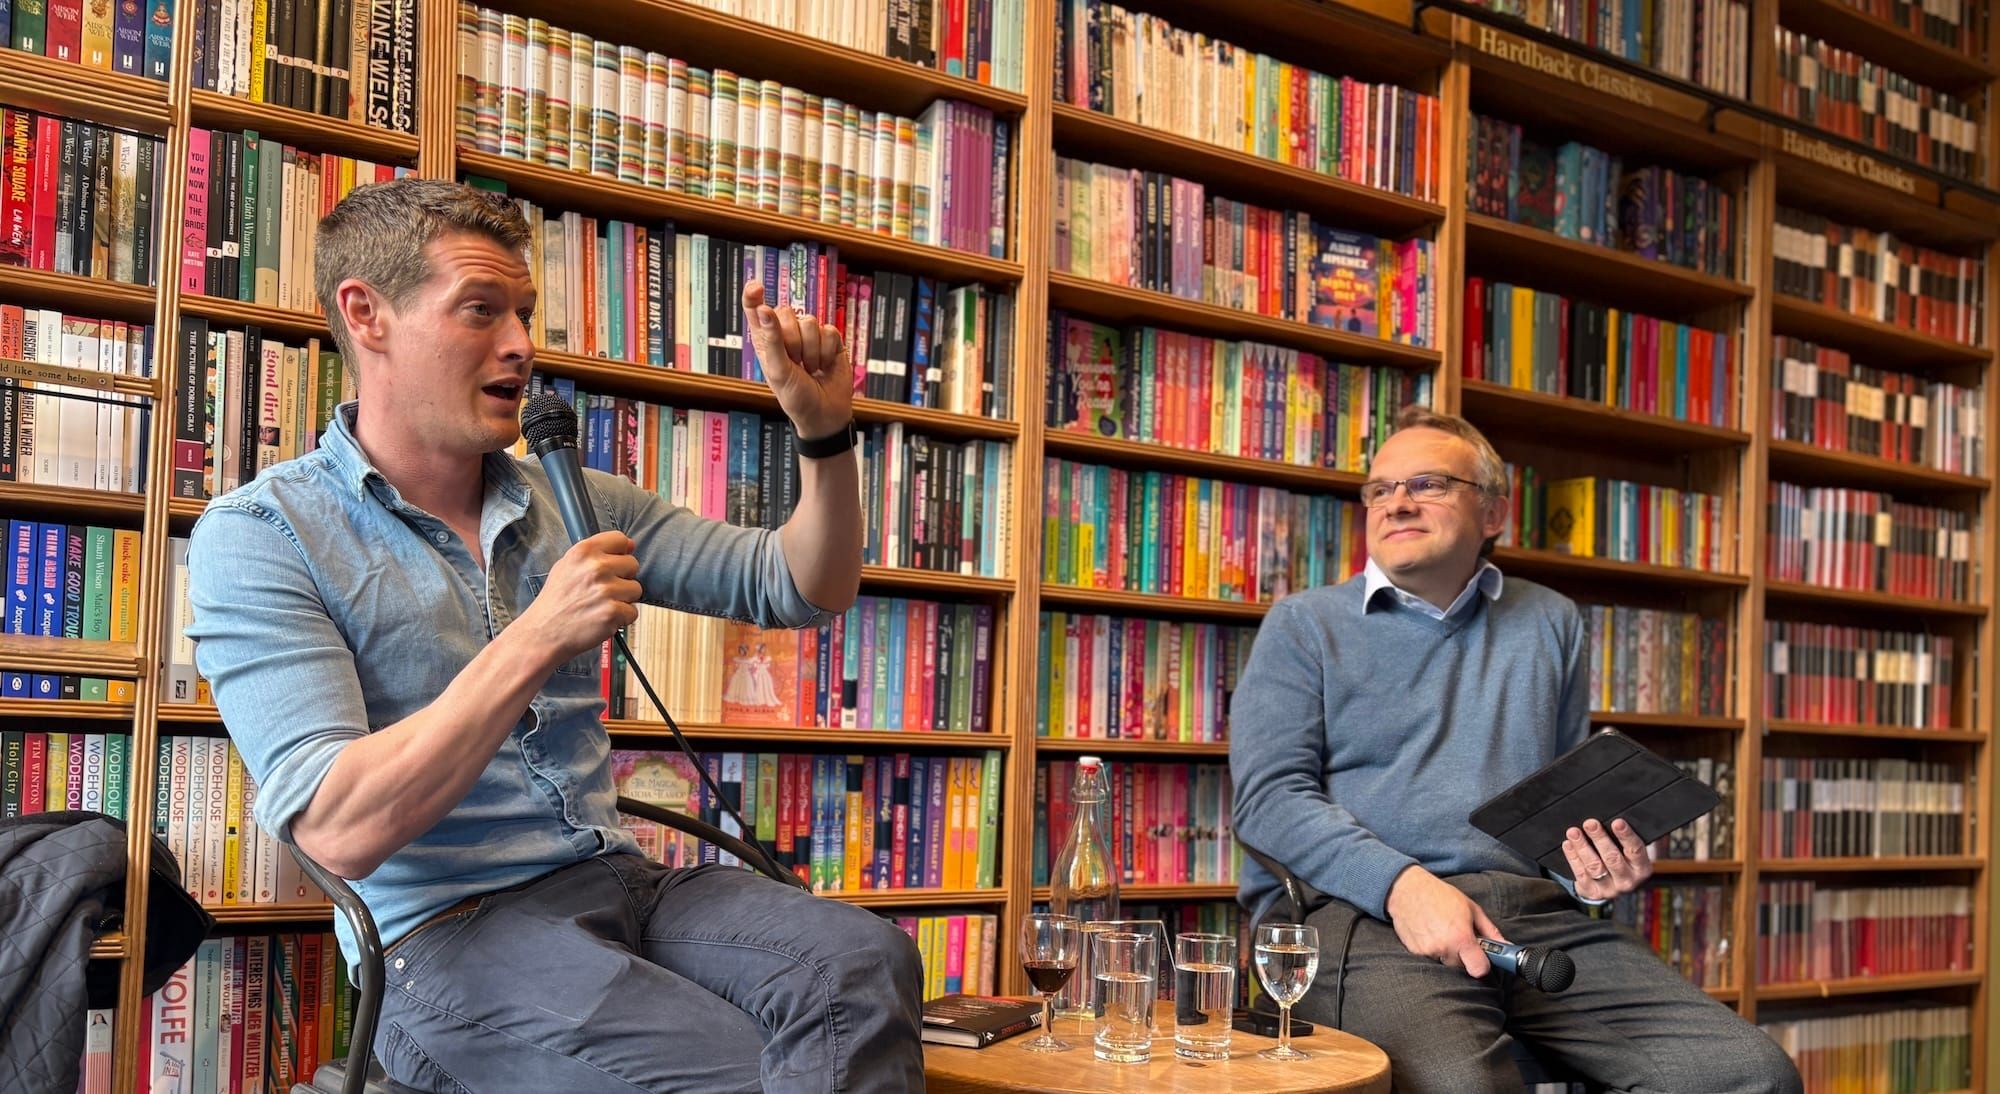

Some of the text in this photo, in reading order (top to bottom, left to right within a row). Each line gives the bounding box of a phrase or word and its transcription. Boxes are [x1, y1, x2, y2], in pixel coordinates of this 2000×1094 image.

[1479, 26, 1652, 106] Hardback Classics
[63, 137, 75, 166] Wesley
[81, 139, 93, 168] Wesley
[119, 146, 131, 174] Wesley
[191, 151, 205, 163] YOU
[1782, 129, 1915, 194] Hardback Classics
[99, 136, 109, 213] Wesley Second Fiddle
[188, 179, 205, 190] NOW
[190, 165, 204, 176] MAY
[11, 166, 26, 245] SQUARE LAI WEN
[188, 193, 203, 203] KILL
[189, 206, 203, 217] THE
[79, 209, 88, 232] Legacy
[185, 219, 205, 231] BRIDE
[242, 196, 255, 257] Edith Wharton
[137, 239, 145, 270] WEDDING
[184, 258, 204, 268] WESTON
[187, 250, 200, 258] KATE
[1322, 252, 1369, 270] JIMENEZ
[648, 238, 661, 331] FOURTEEN DAYS
[4, 335, 10, 345] Be
[13, 365, 89, 384] like some help.
[188, 345, 197, 373] PICTURE
[20, 320, 37, 456] UNDISCOVE GABRIELA WIENER
[188, 373, 196, 385] OF
[263, 349, 280, 423] good dirt
[325, 388, 334, 397] OF
[326, 369, 334, 388] HOUSE
[187, 385, 196, 413] DORIAN
[3, 396, 12, 458] EDGAR WIDEMAN
[186, 413, 195, 433] GRAY
[603, 418, 611, 454] Venice Tales
[711, 418, 722, 462] SLUTS
[587, 437, 595, 453] Tales
[763, 432, 771, 467] WINTER
[783, 434, 792, 505] WINTER SPIRITS
[16, 525, 31, 585] THINK AGAIN
[43, 529, 59, 589] THINK AGAIN
[69, 534, 82, 568] MAKE
[122, 536, 132, 561] black
[67, 571, 81, 601] GOOD
[92, 534, 105, 634] Shaun Wilson Boy
[121, 562, 130, 585] cake
[819, 652, 827, 693] ALEXANDER
[876, 656, 886, 689] GAME
[5, 742, 19, 794] Holy City
[30, 740, 41, 805] TIM WINTON
[68, 740, 83, 810] WODEHOU
[87, 740, 101, 810] WODEHOU
[157, 741, 170, 823] WODEHOUSE
[173, 742, 187, 823] WODEHOUSE
[192, 742, 206, 822] WODEHOUSE
[210, 742, 224, 821] WODEHOUSE
[223, 948, 232, 982] TOBIAS
[321, 947, 334, 1008] The Weekend
[231, 969, 244, 1025] MEG WOLITZER
[245, 949, 264, 1079] INTERESTINGS MEG WOLITZER
[279, 942, 294, 1079] THE FEMALE PERSUASION MEG WOLITZER
